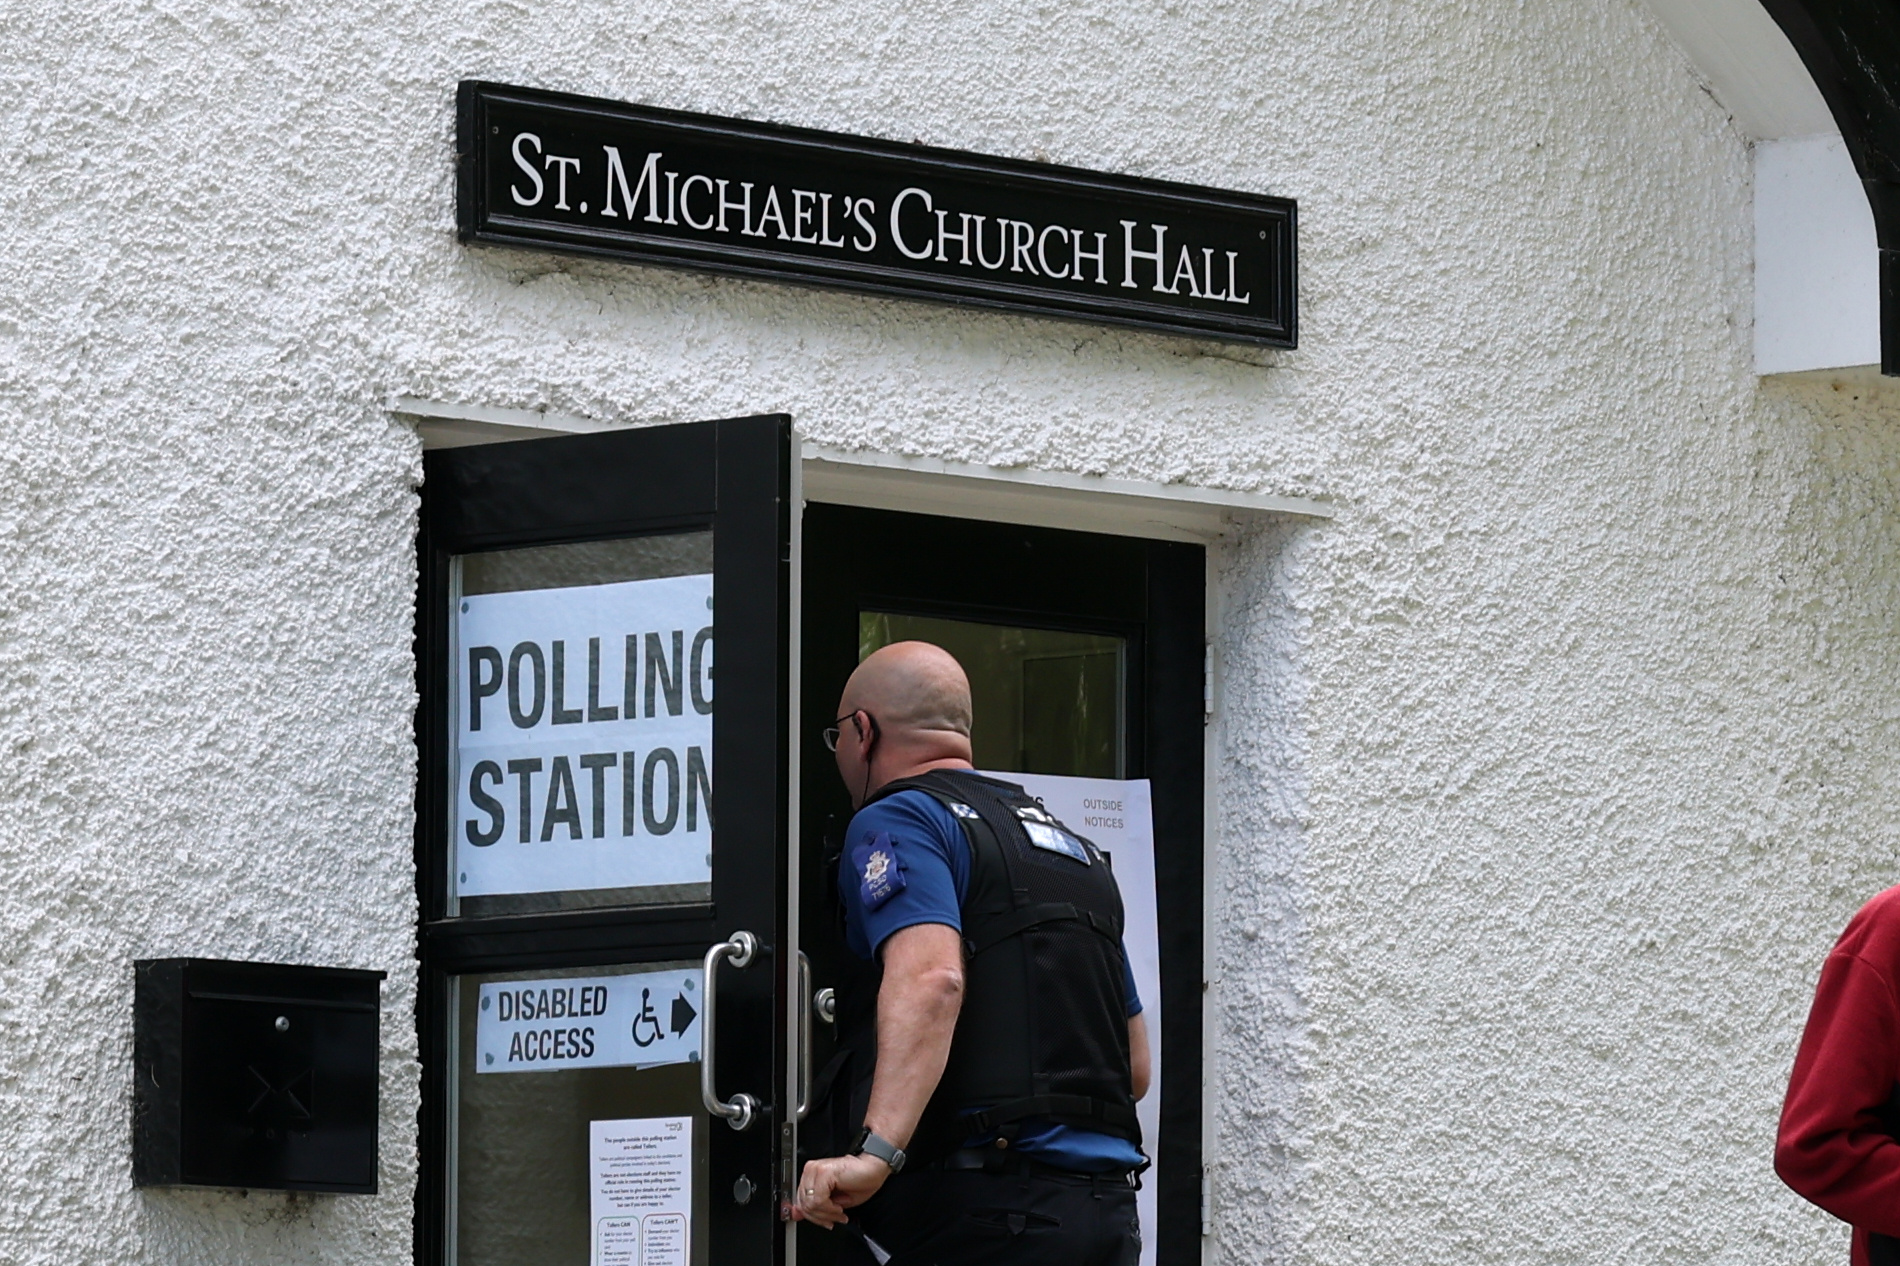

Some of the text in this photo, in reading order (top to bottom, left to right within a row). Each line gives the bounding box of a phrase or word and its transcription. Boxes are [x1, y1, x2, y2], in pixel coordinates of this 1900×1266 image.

[600, 144, 878, 253] MICHAEL'S
[889, 187, 1109, 286] CHURCH
[1118, 219, 1251, 304] HALL
[468, 625, 714, 732] POLLING
[465, 745, 714, 848] STATION
[1083, 798, 1124, 812] OUTSIDE
[1084, 816, 1124, 830] NOTICES
[498, 985, 608, 1022] DISABLED
[508, 1026, 596, 1063] ACCESS
